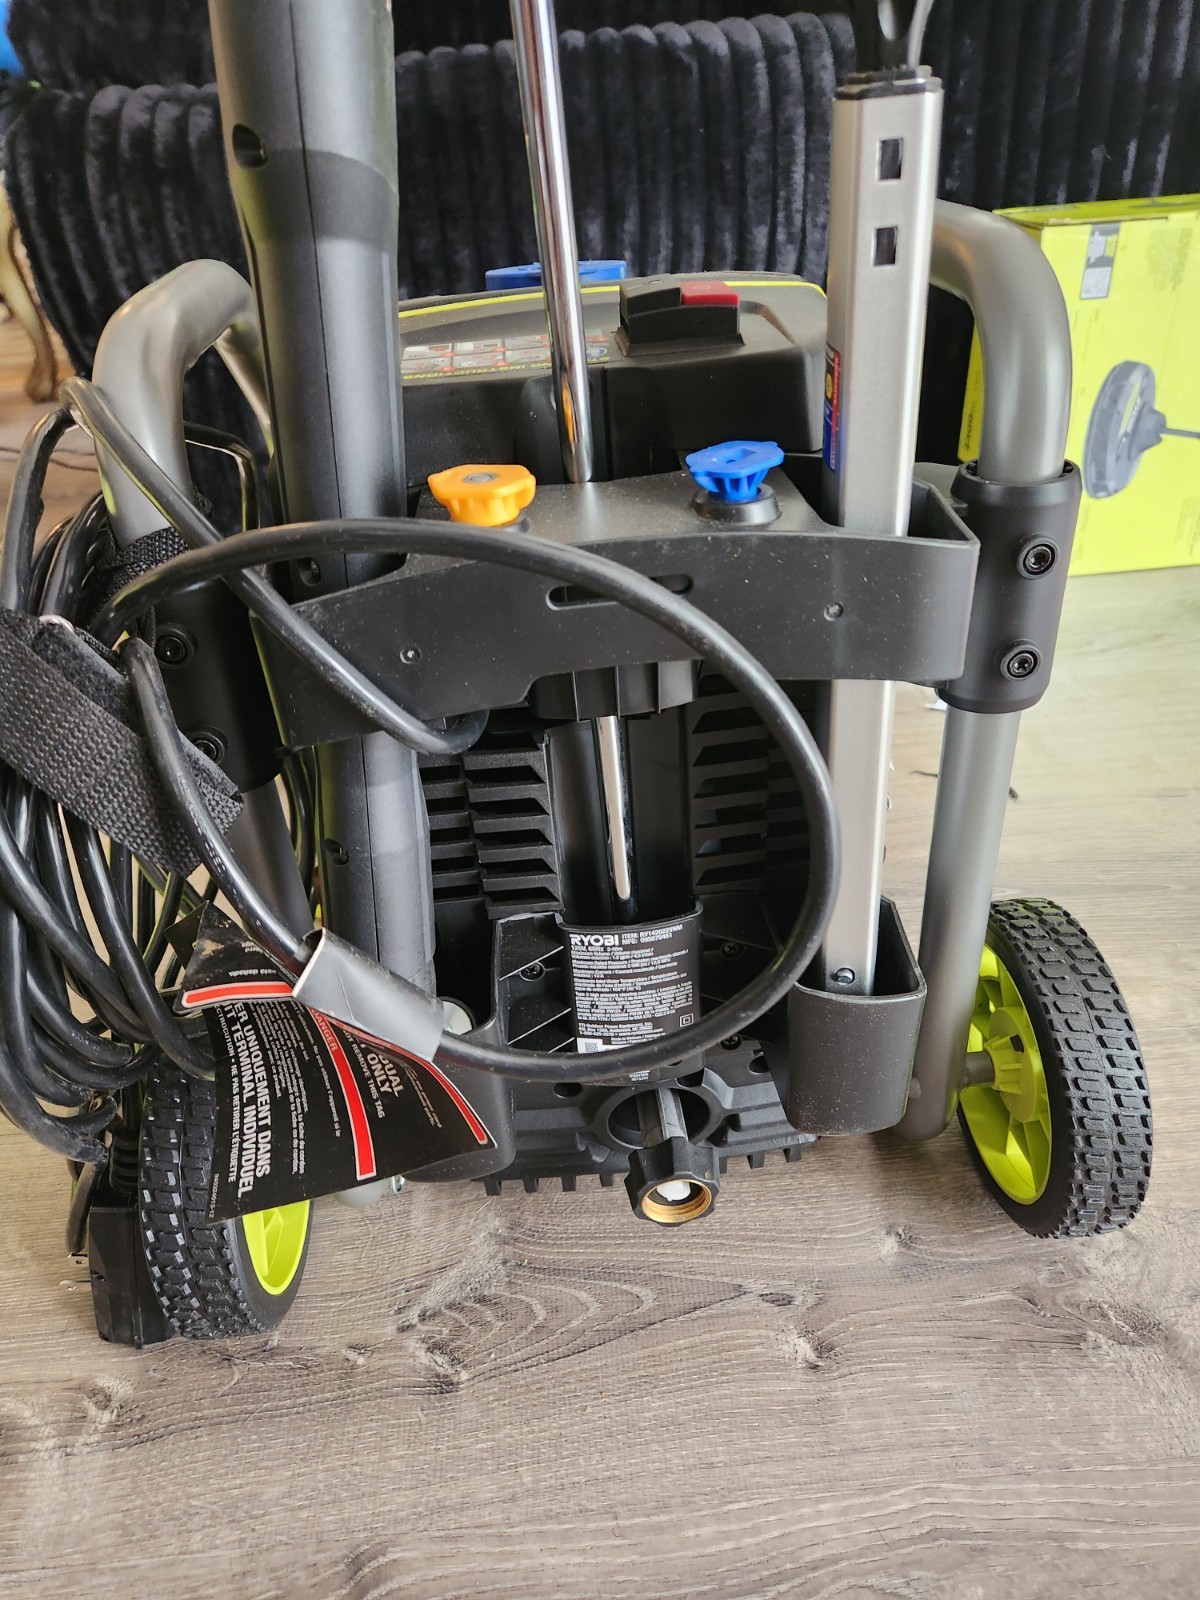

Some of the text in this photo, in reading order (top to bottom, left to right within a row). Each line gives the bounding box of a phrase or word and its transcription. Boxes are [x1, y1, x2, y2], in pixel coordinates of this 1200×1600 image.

[569, 934, 619, 946] RYOBI
[231, 1021, 255, 1103] TERMINAL
[231, 1064, 238, 1077] NE
[232, 1077, 240, 1095] PAS
[243, 1024, 272, 1126] UNIQUEMENT
[352, 1043, 371, 1078] REMOVE
[367, 1078, 380, 1100] THIS
[374, 1100, 386, 1119] TAG
[367, 1053, 392, 1093] ONLY
[232, 1095, 240, 1131] RETIRER
[228, 1131, 241, 1183] L'ÉTIQUETTE
[237, 1104, 257, 1199] INDIVIDUEL
[256, 1130, 272, 1178] DANS
